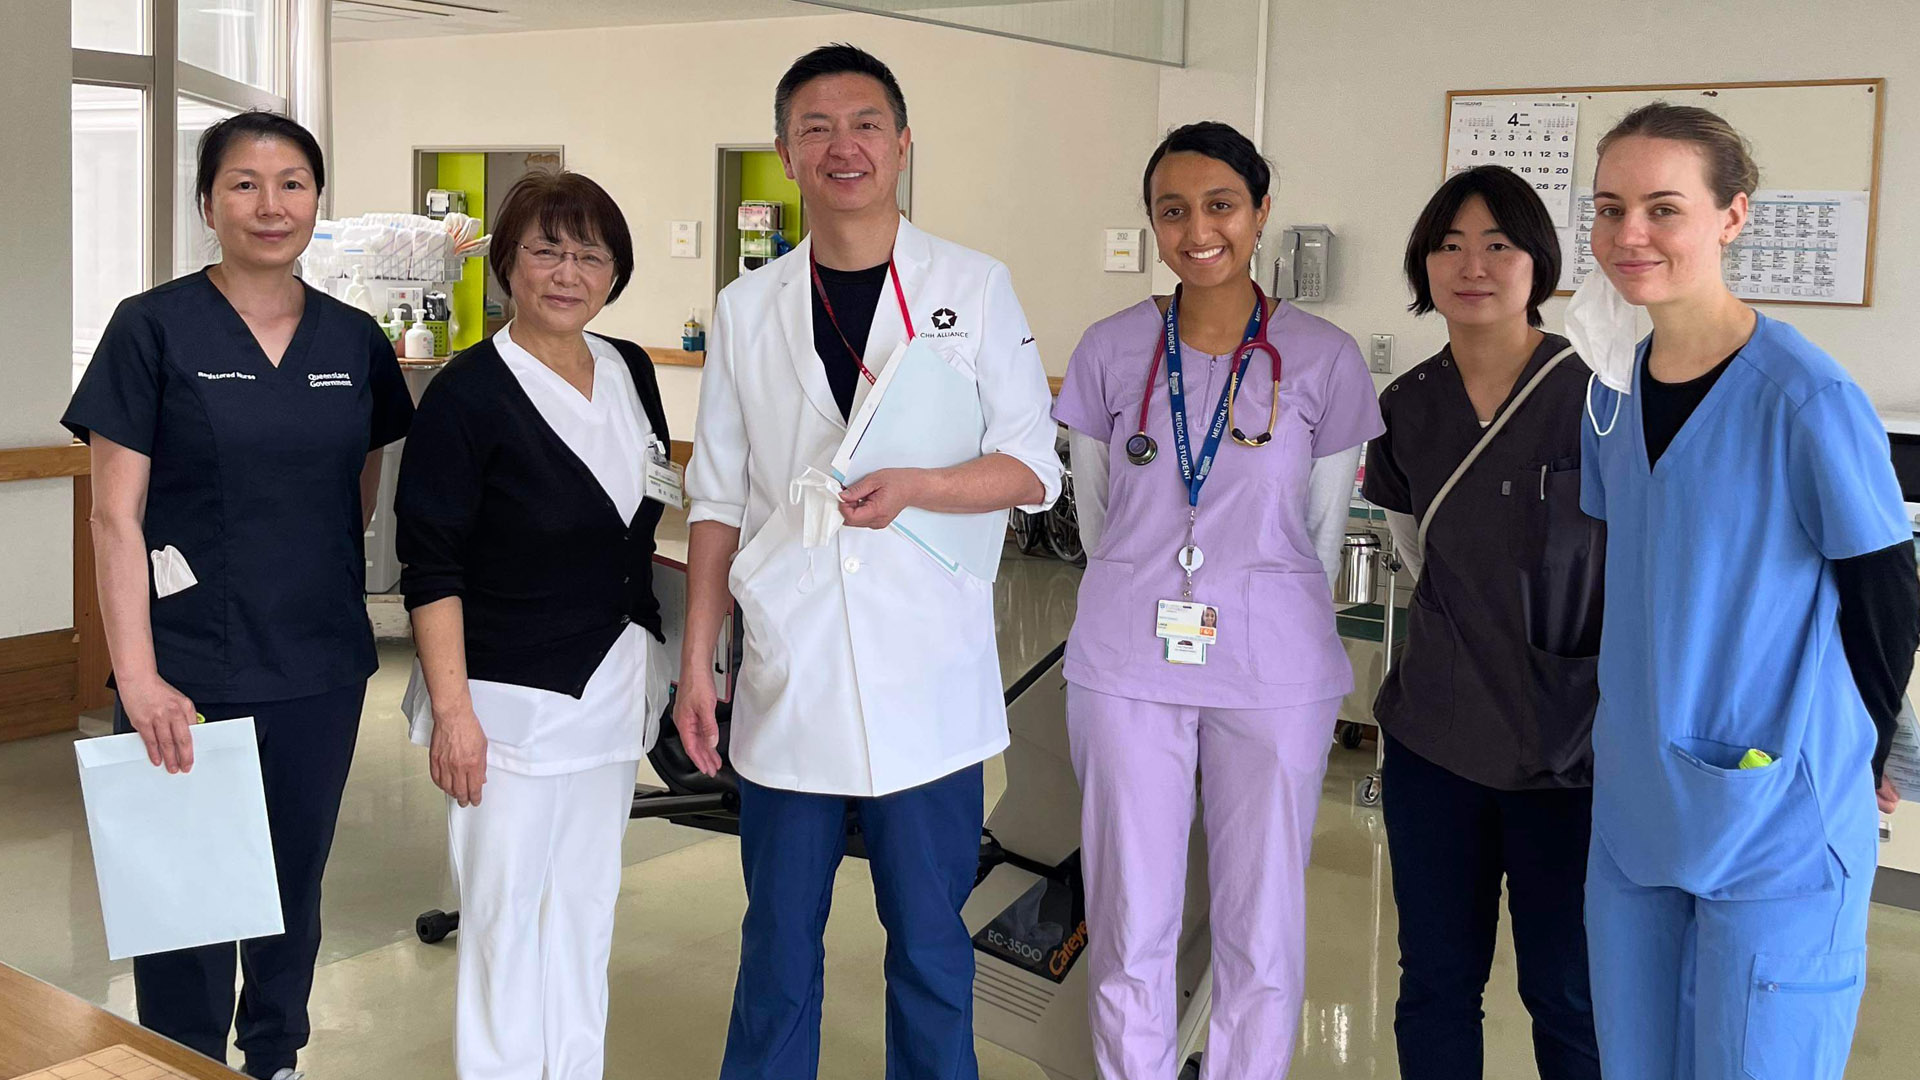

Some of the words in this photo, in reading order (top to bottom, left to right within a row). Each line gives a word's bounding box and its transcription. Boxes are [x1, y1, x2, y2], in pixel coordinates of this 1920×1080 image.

[1507, 113, 1519, 127] 4
[936, 331, 969, 339] ALLIANCE
[1167, 323, 1176, 355] STUDENT
[236, 371, 256, 380] Nurse
[308, 371, 350, 381] Queensland
[309, 380, 352, 388] Government
[1175, 411, 1185, 444] MEDICAL
[1211, 408, 1228, 439] MEDICAL
[1179, 444, 1191, 480] STUDENT
[987, 929, 1042, 962] EC-3500
